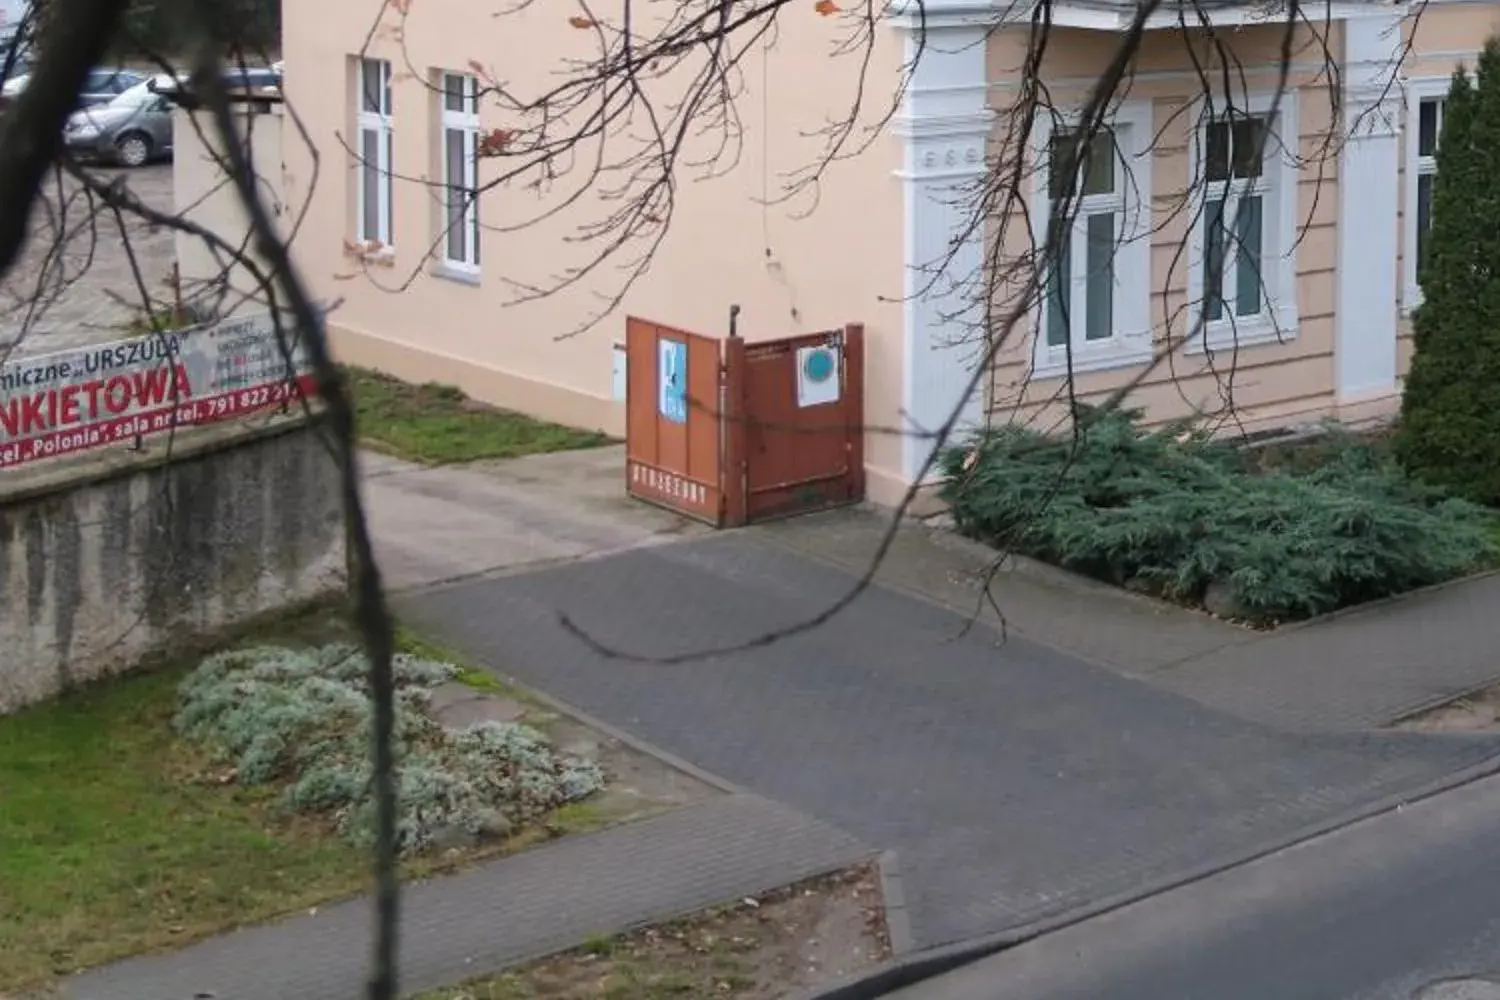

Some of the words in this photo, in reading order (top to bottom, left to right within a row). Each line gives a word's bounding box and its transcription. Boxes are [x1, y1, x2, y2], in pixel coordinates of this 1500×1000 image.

[115, 415, 149, 435] sala
[176, 402, 203, 422] tel.
[208, 395, 236, 416] 791
